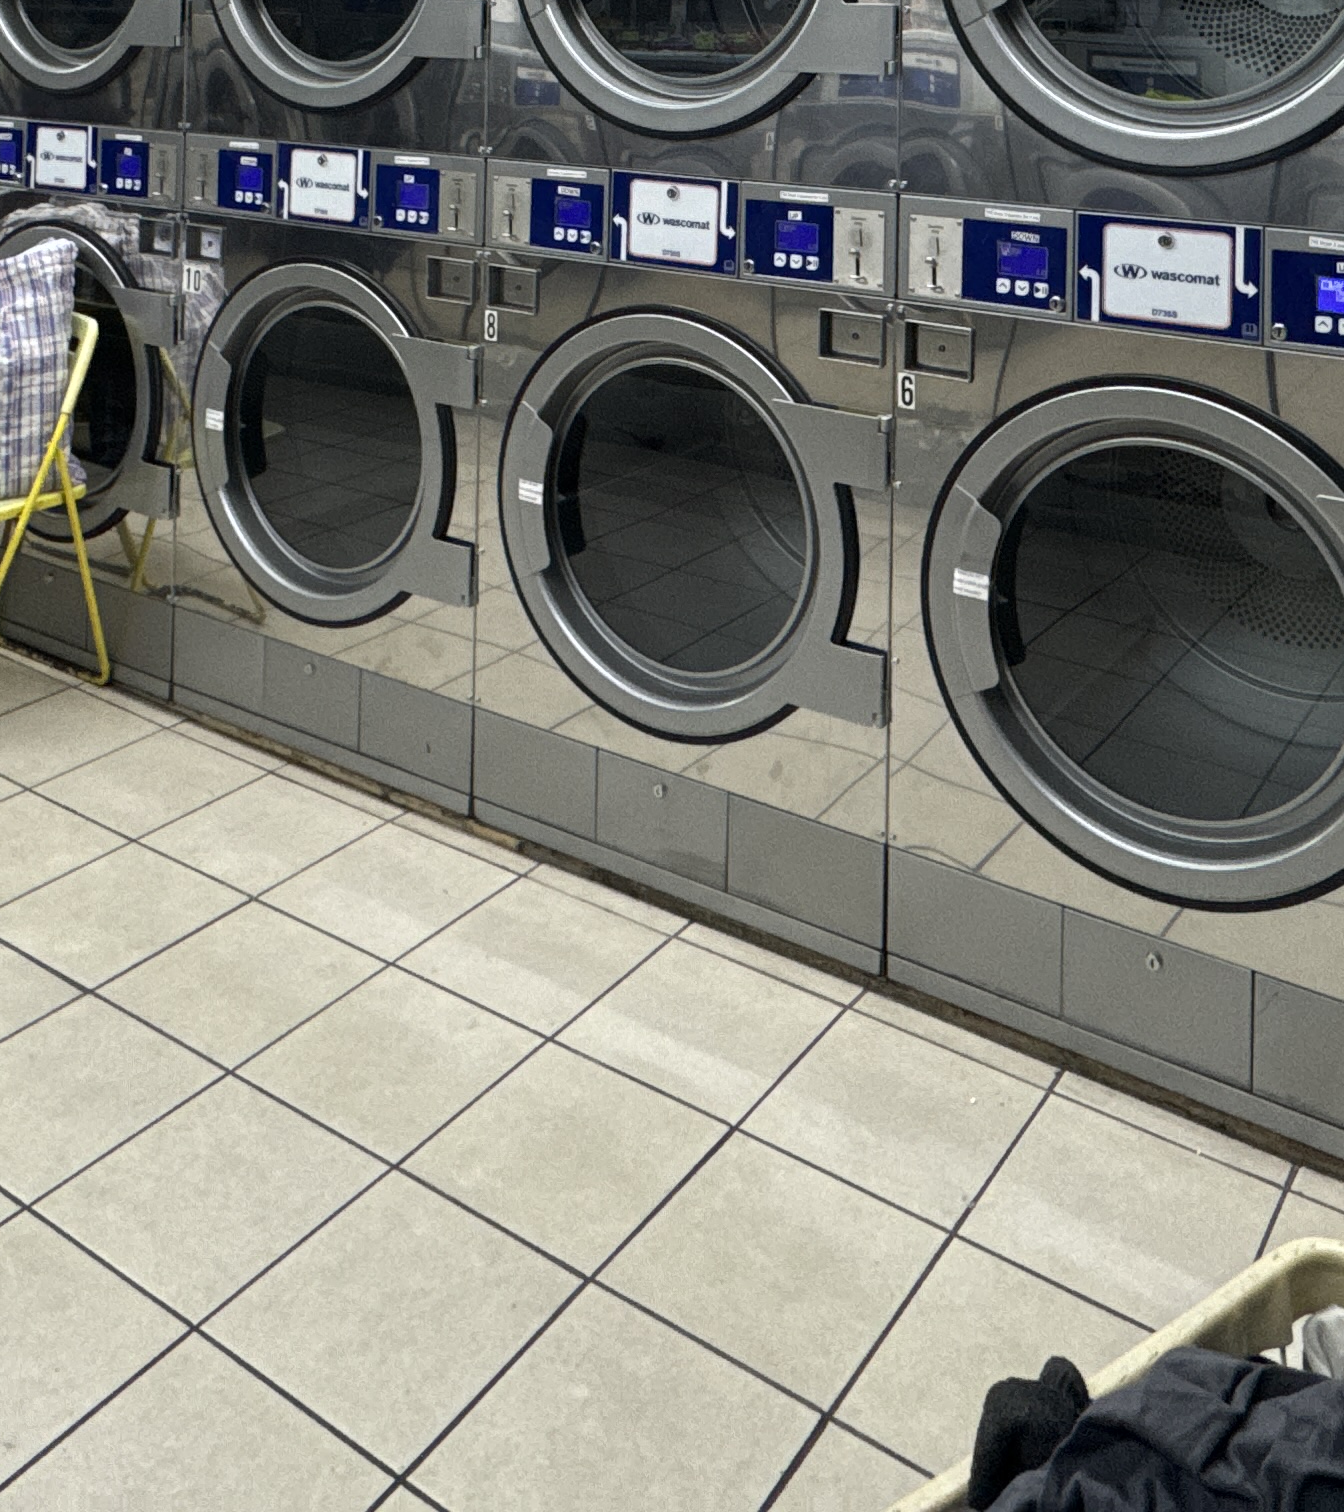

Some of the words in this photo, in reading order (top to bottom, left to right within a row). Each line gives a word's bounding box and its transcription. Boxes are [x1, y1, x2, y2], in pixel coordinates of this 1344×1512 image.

[314, 181, 350, 192] wascomat
[662, 216, 710, 231] wascomat
[186, 268, 200, 291] 10
[1151, 267, 1221, 287] wascomat
[487, 313, 495, 338] 8
[899, 375, 914, 407] 6
